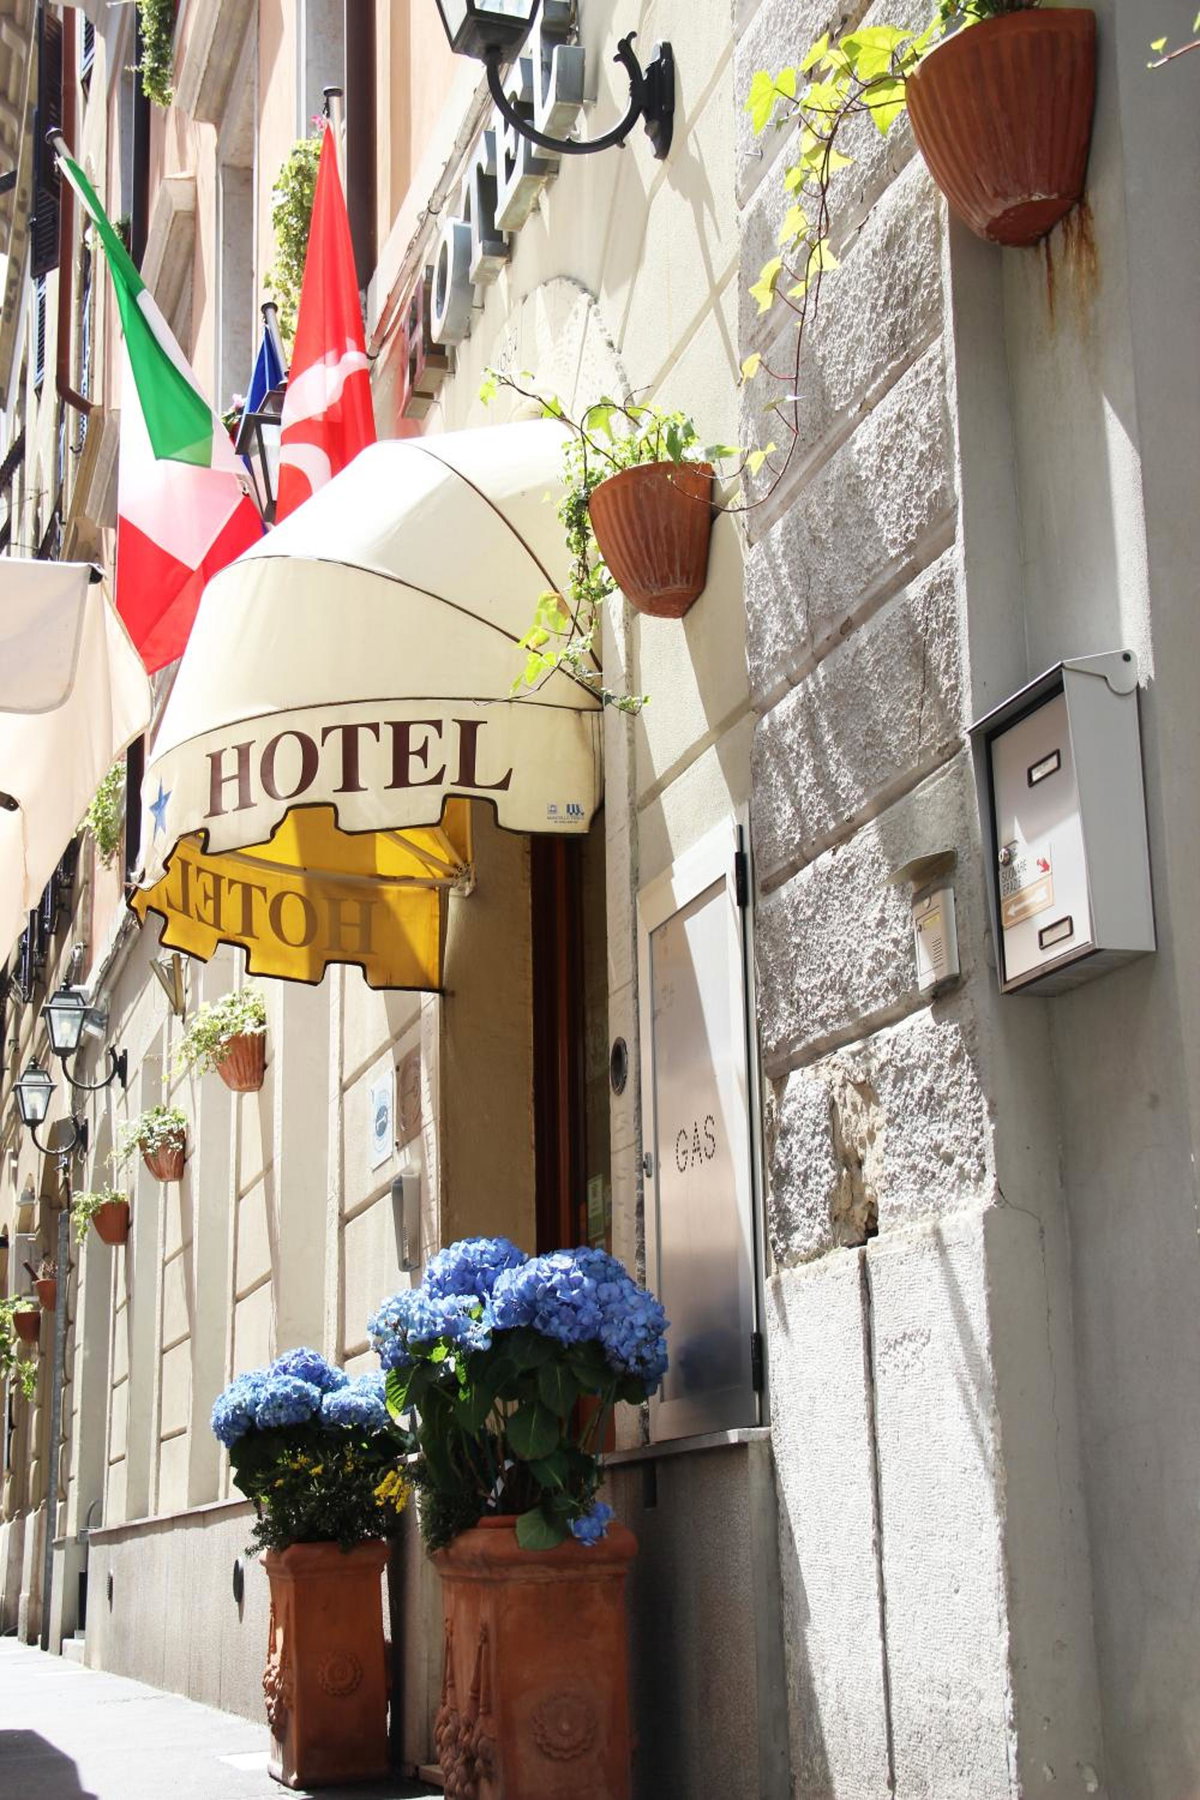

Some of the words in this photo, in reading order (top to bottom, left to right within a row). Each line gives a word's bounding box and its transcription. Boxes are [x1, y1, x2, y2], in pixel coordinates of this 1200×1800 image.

[402, 0, 585, 418] HOTEL
[203, 718, 514, 819] HOTEL
[675, 1114, 716, 1173] GAS
